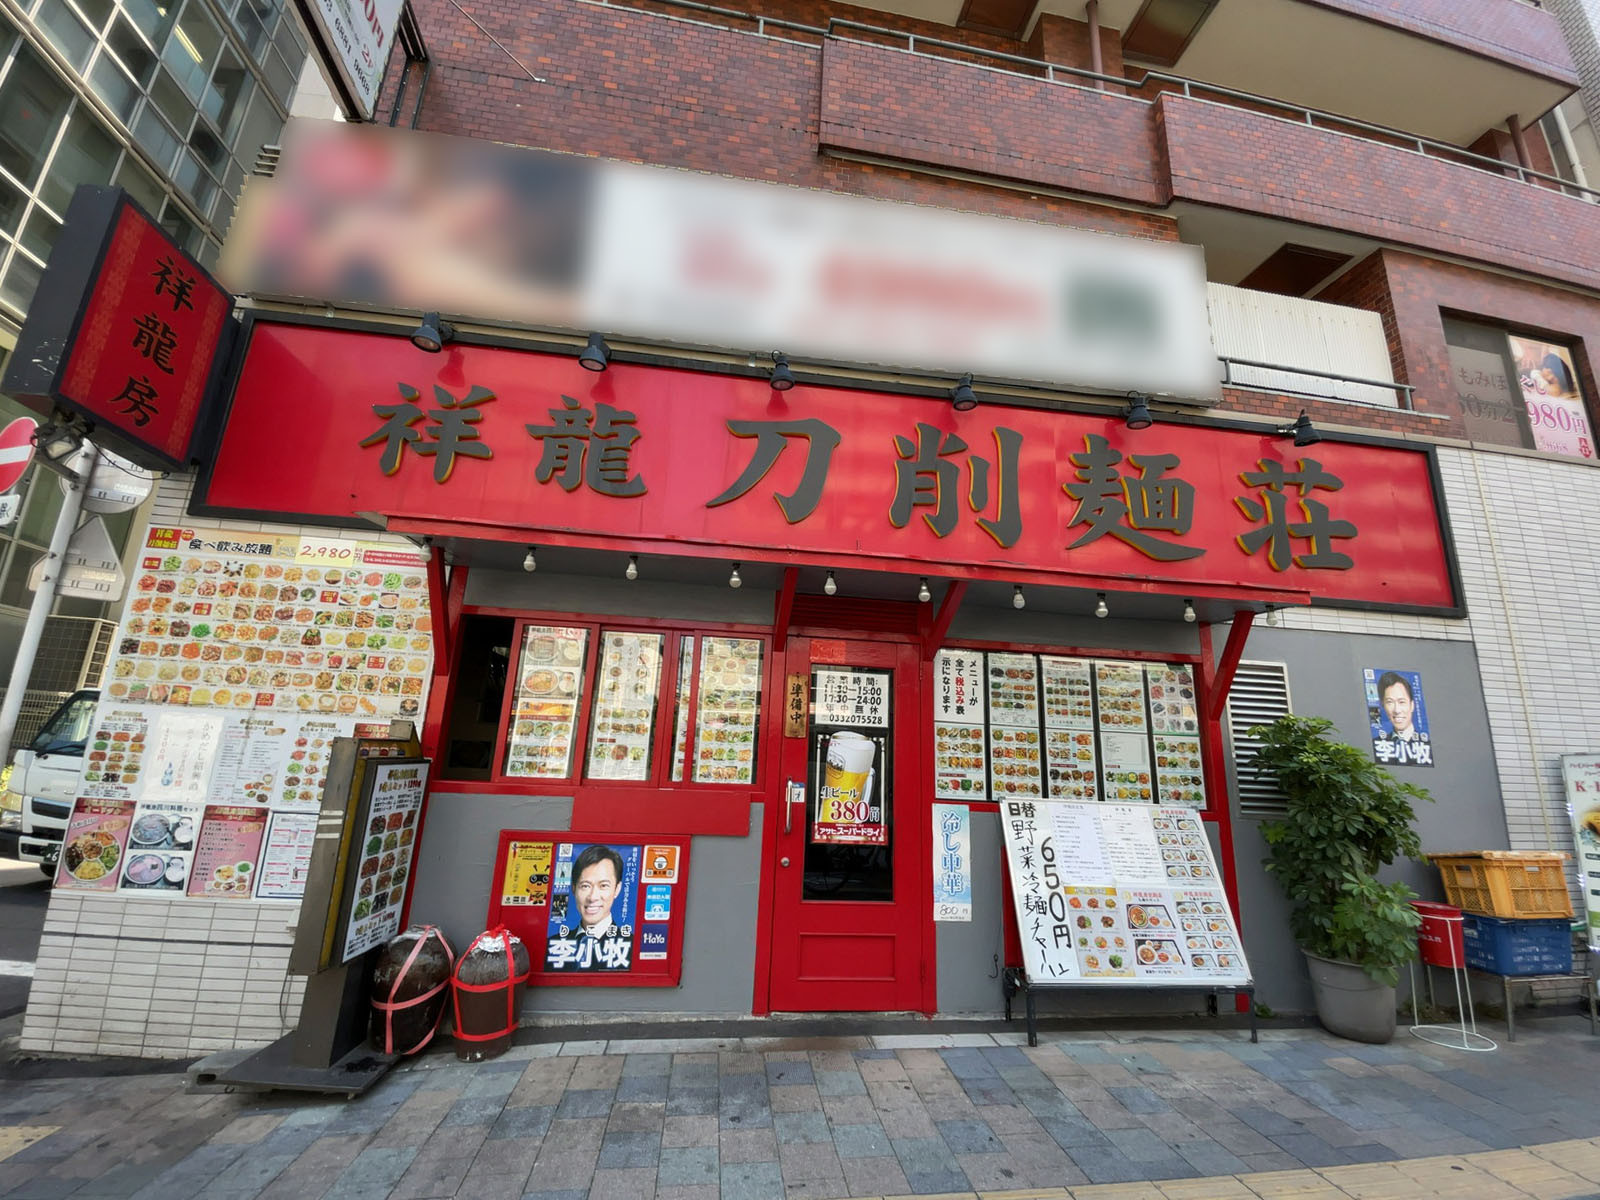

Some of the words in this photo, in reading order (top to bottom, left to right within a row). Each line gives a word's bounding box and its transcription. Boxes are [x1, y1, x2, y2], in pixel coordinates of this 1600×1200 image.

[109, 256, 197, 427] 祥龍房
[360, 382, 1358, 572] 祥龍刀削麺荘
[300, 545, 352, 560] 2,980
[942, 657, 951, 714] 示になります
[955, 658, 965, 715] 全て税込み表
[969, 660, 978, 706] メニューが
[790, 683, 803, 724] 準備中
[826, 703, 878, 715] 年中無休
[829, 714, 883, 725] 0332075528
[1374, 740, 1432, 764] 李小牧
[820, 786, 858, 799] 生ビール
[1008, 802, 1036, 818] 日替
[820, 827, 880, 836] アサヒスーパードライ
[943, 812, 964, 896] 冷し中華
[1041, 837, 1072, 949] 650円
[560, 924, 632, 937] りこまき
[547, 938, 632, 968] 李小牧
